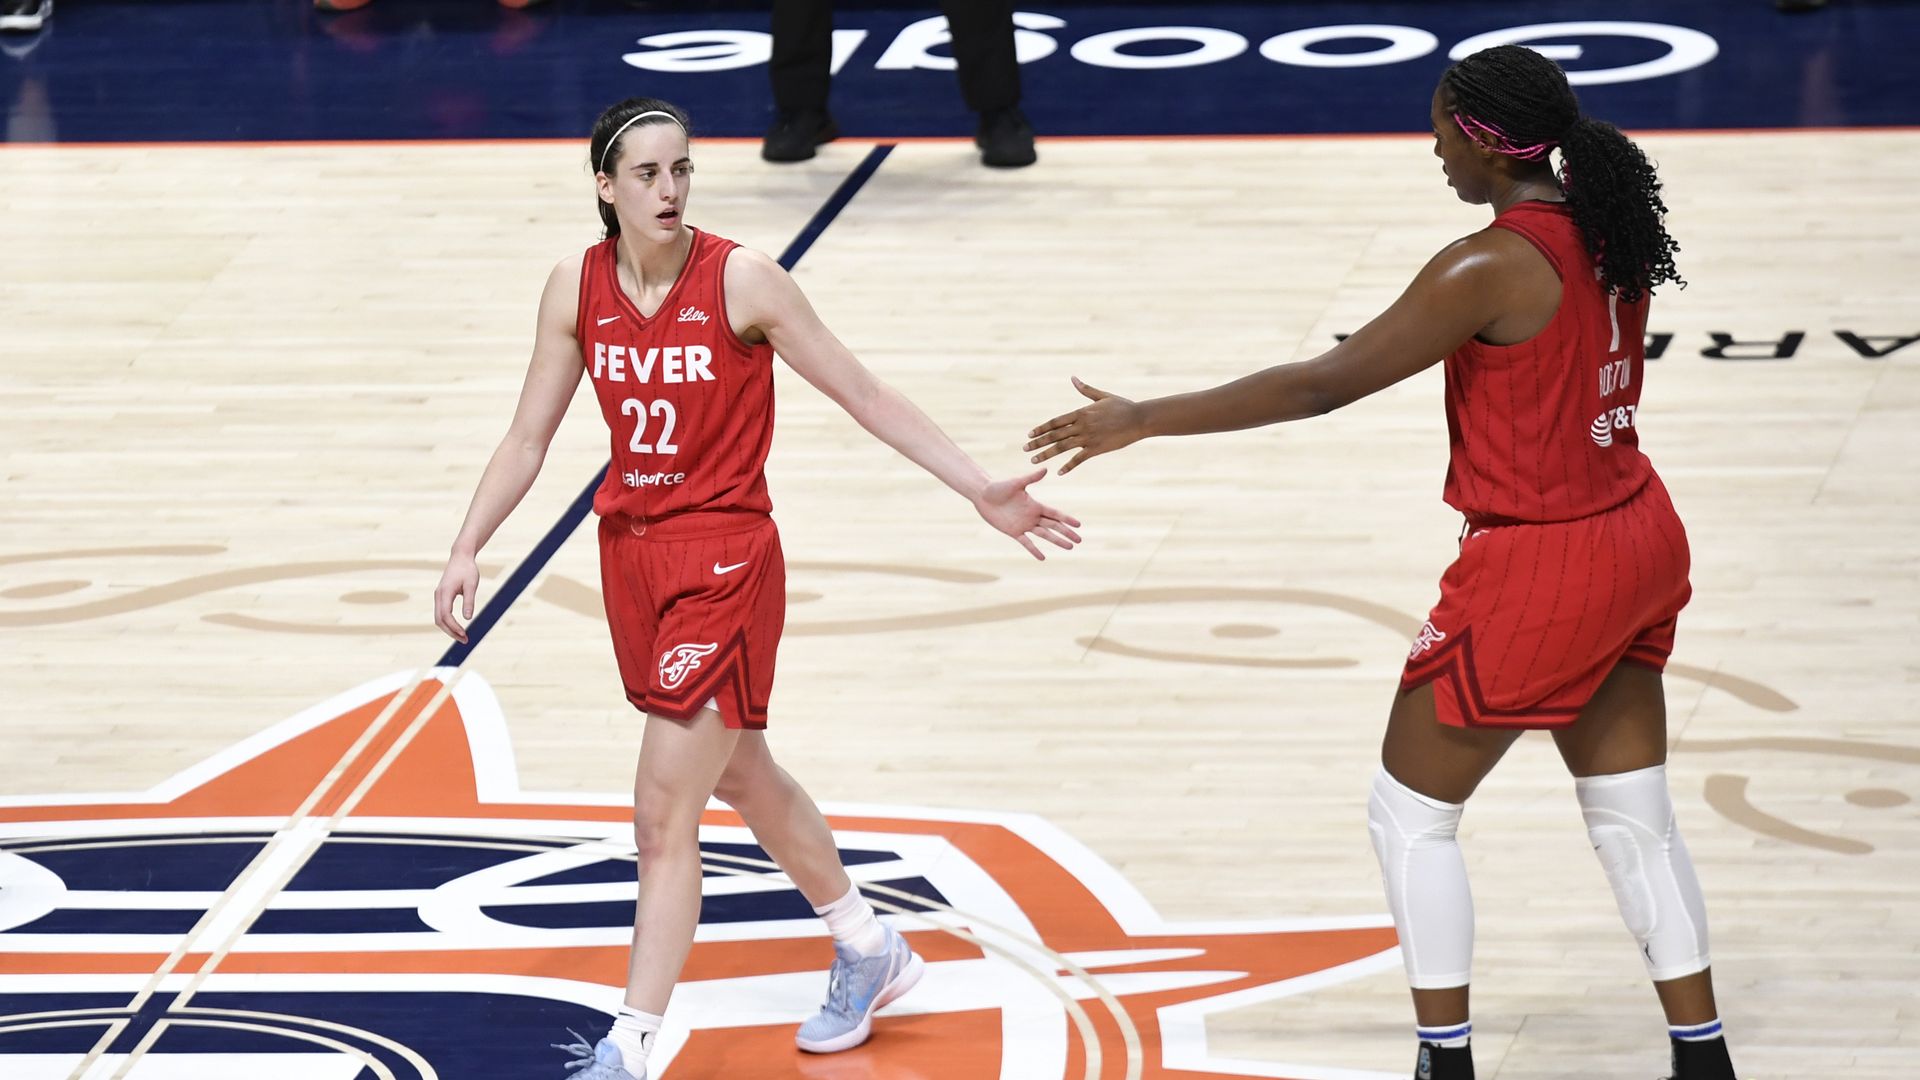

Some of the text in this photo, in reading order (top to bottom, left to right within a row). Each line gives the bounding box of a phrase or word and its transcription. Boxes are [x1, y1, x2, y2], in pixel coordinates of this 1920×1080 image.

[677, 306, 710, 325] Lilly
[593, 342, 716, 384] FEVER
[621, 398, 679, 455] 22
